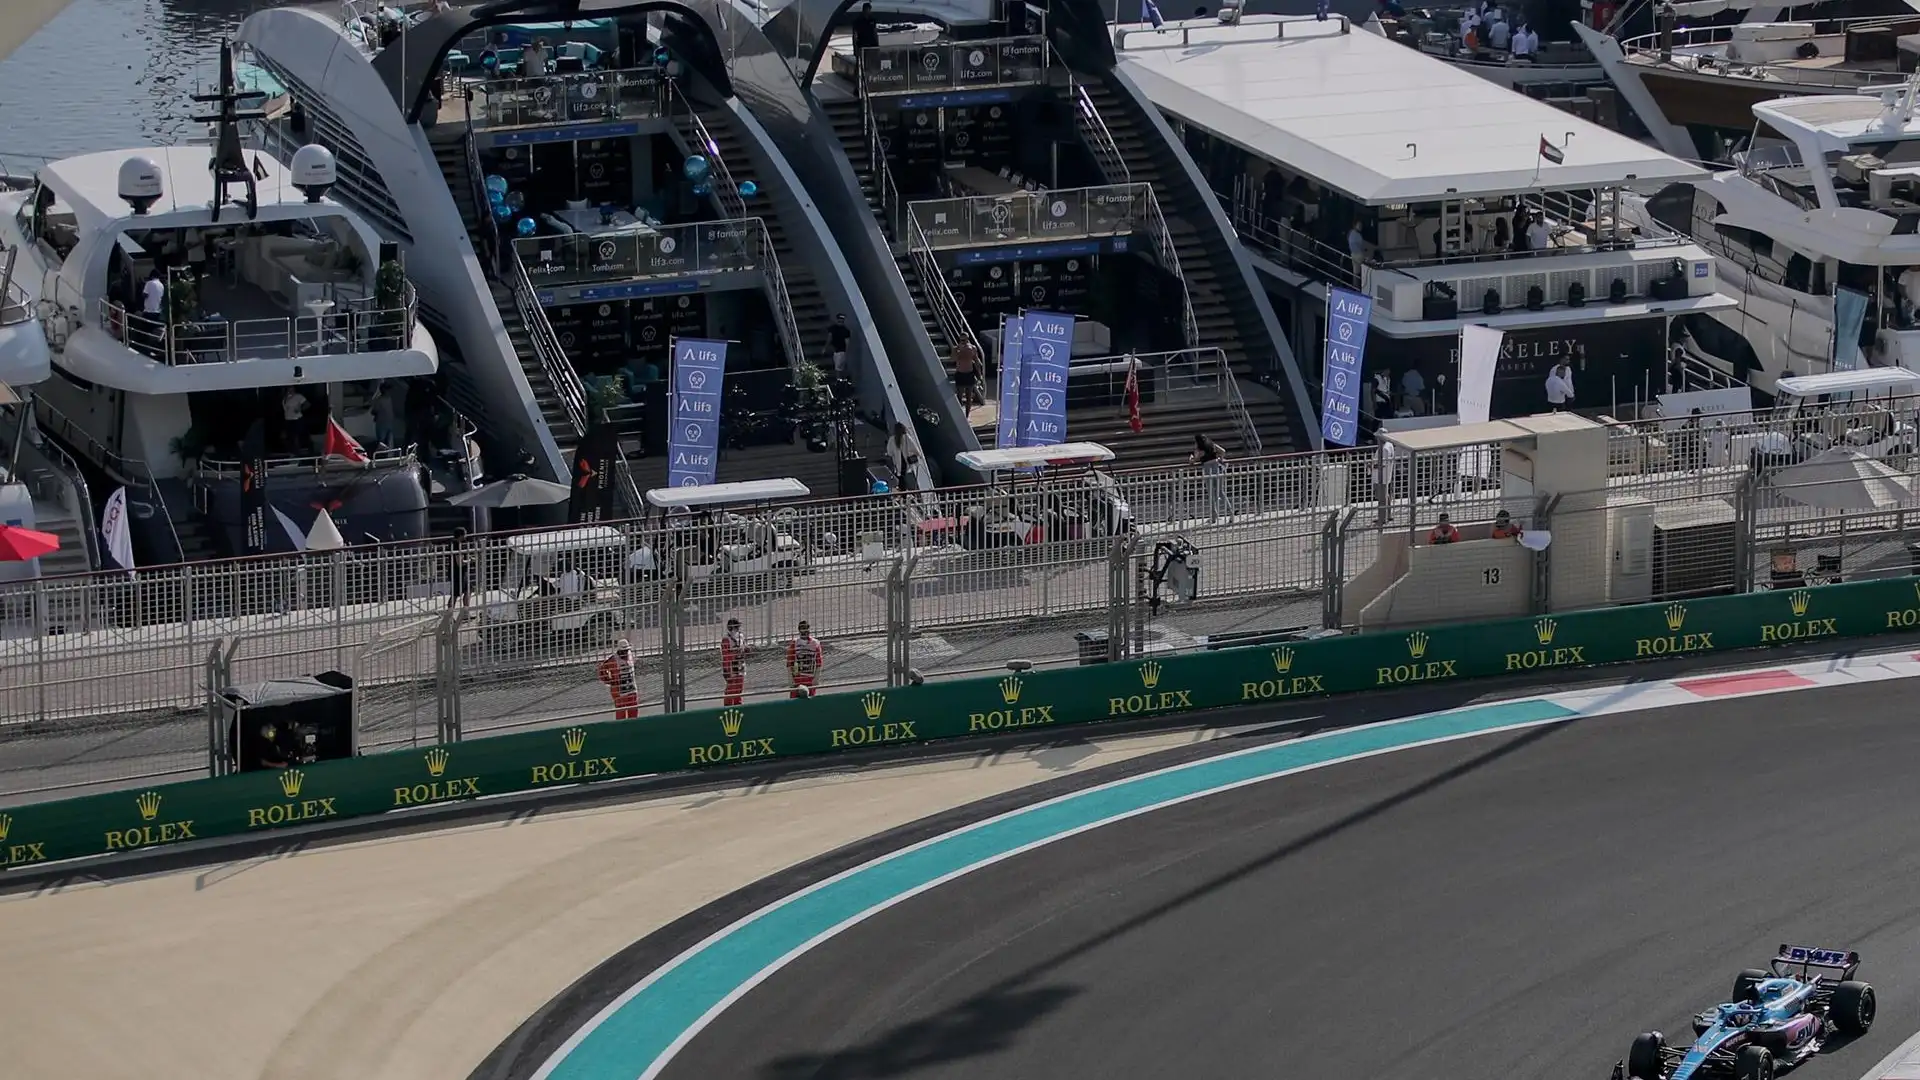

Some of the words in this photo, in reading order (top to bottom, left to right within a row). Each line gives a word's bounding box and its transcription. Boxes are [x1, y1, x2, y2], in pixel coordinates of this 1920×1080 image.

[960, 69, 993, 79] lif3.com
[651, 256, 684, 266] lif3.com
[1347, 303, 1363, 315] lif3
[1047, 322, 1065, 336] lif3
[699, 351, 717, 361] lif3
[1341, 353, 1355, 365] lif3
[1449, 339, 1577, 364] BKELEY
[1045, 373, 1062, 384] lif3
[694, 401, 712, 412] lif3
[1337, 402, 1350, 414] lif3
[1042, 422, 1058, 433] lif3
[690, 454, 709, 465] lif3
[1484, 568, 1499, 584] 13
[1760, 618, 1838, 642] ROLEX
[1635, 631, 1713, 656] ROLEX
[1506, 647, 1585, 669] ROLEX
[1376, 660, 1458, 684] ROLEX
[1242, 674, 1327, 700] ROLEX
[1109, 690, 1193, 715] ROLEX
[969, 706, 1054, 731] ROLEX
[832, 721, 916, 747] ROLEX
[690, 738, 776, 764] ROLEX
[532, 757, 618, 783] ROLEX
[394, 776, 480, 805] ROLEX
[249, 797, 337, 826] ROLEX
[106, 821, 194, 849] ROLEX
